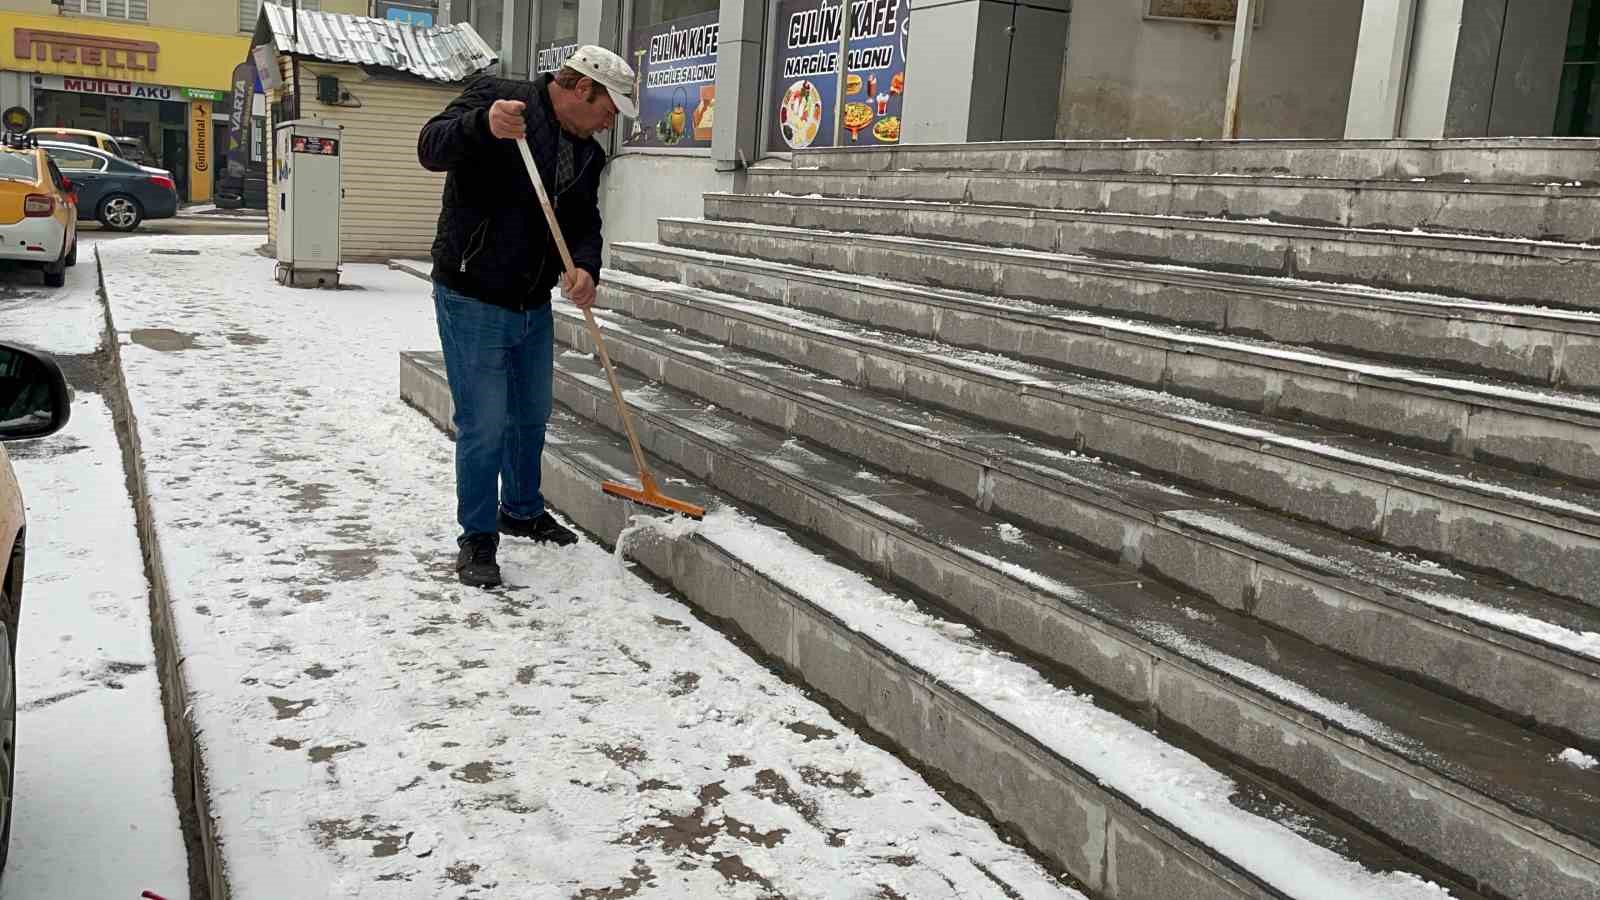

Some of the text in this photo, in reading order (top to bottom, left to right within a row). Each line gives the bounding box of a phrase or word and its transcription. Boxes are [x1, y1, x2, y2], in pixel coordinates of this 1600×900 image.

[688, 23, 719, 58] KAFE
[849, 0, 899, 40] KAFE
[14, 28, 160, 71] PIRELLI
[784, 45, 893, 77] NARGİLE ALONU
[231, 80, 246, 132] VARTA
[195, 119, 209, 172] Continental
